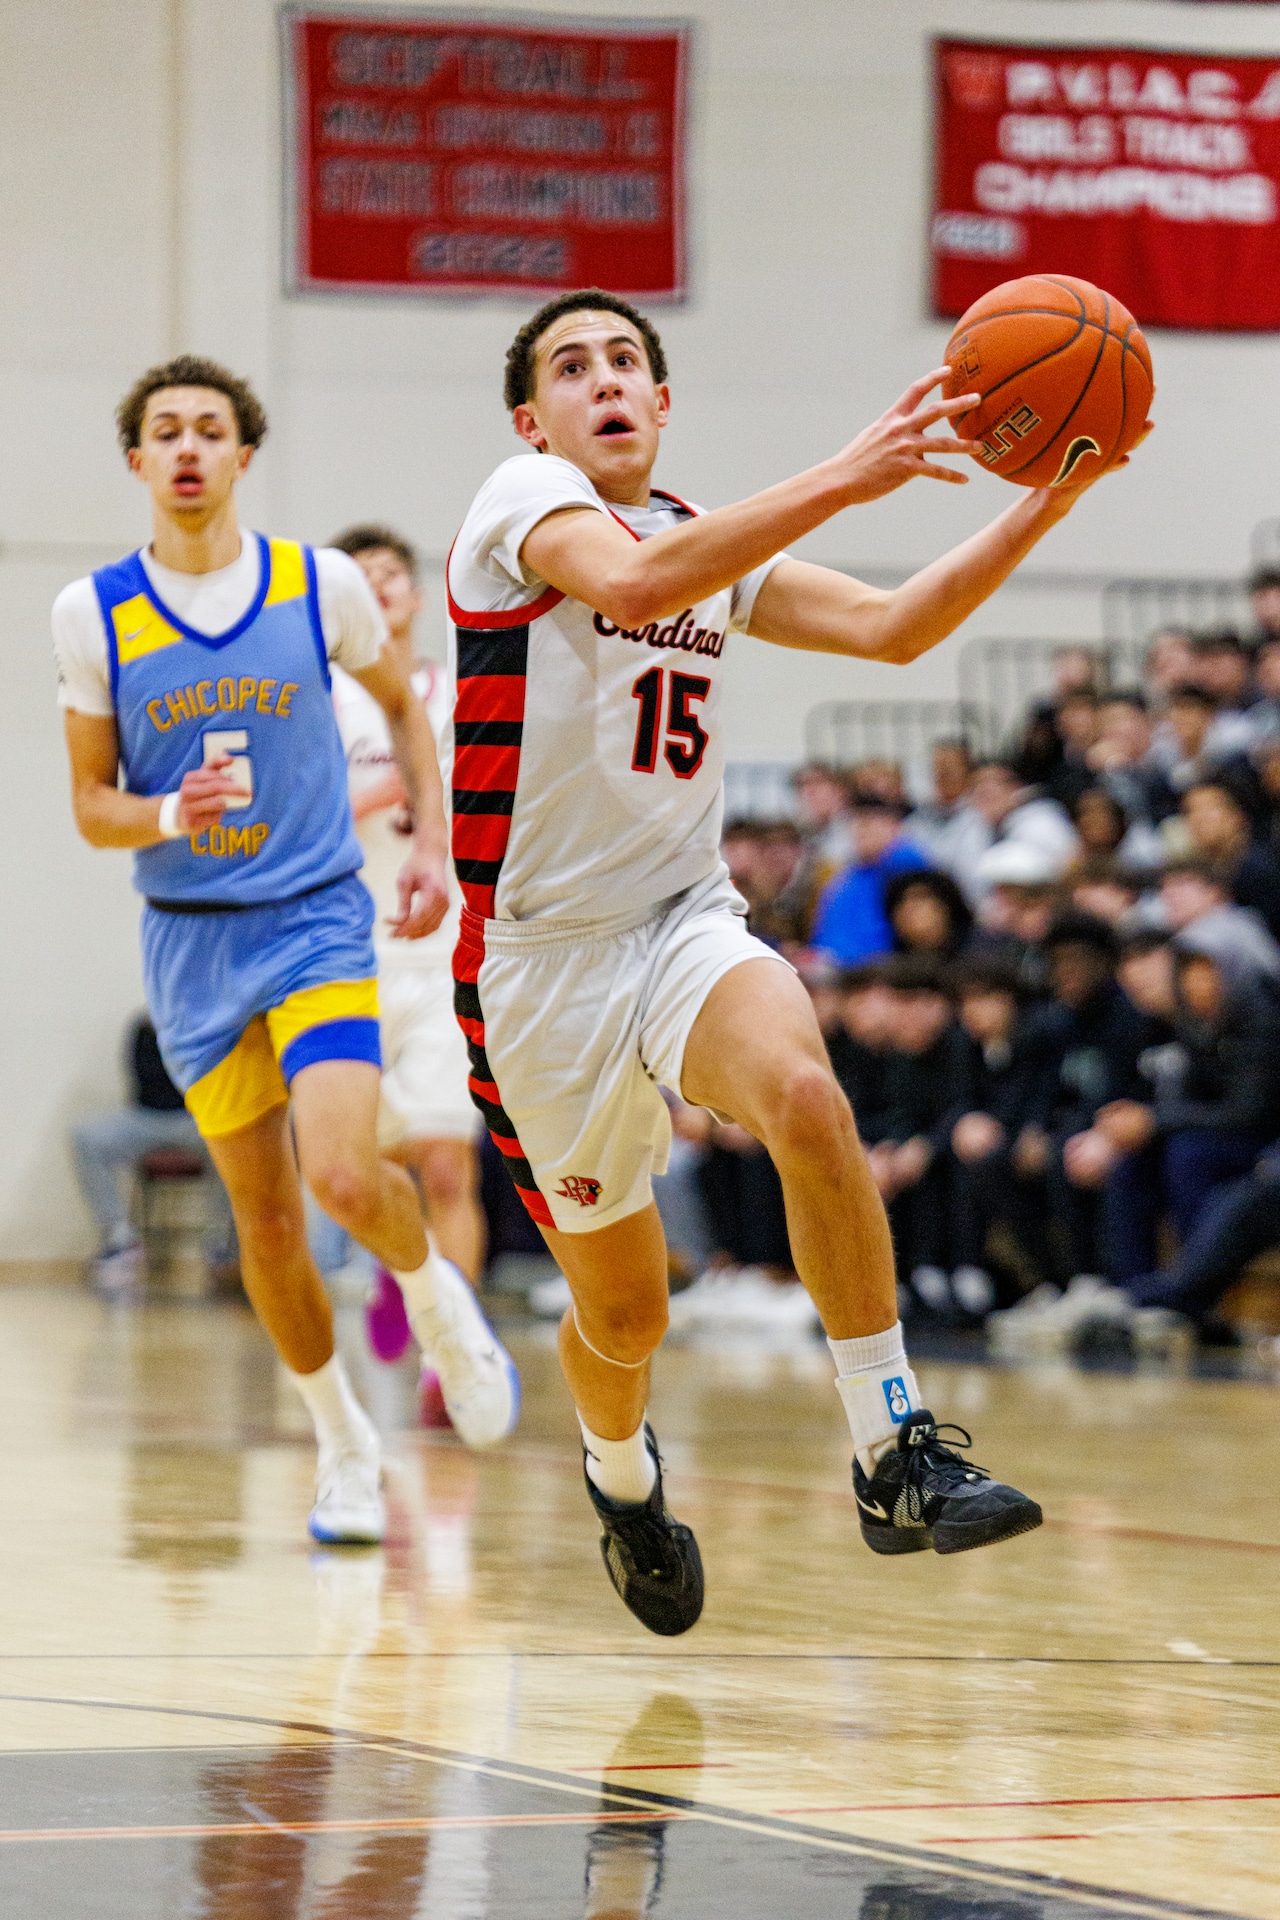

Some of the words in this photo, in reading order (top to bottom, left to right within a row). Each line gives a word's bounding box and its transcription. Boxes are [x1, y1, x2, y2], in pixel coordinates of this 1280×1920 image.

[332, 32, 650, 101] SOFTBALL
[999, 112, 1116, 164] GIRLS
[1122, 114, 1252, 171] TRACK
[319, 156, 437, 219] STATE
[449, 162, 664, 227] CHAMPIONS
[973, 161, 1275, 226] CHAMPIONS
[146, 677, 299, 732] CHICOPEE
[631, 666, 711, 780] 15
[201, 728, 253, 810] 5
[190, 822, 271, 857] COMP
